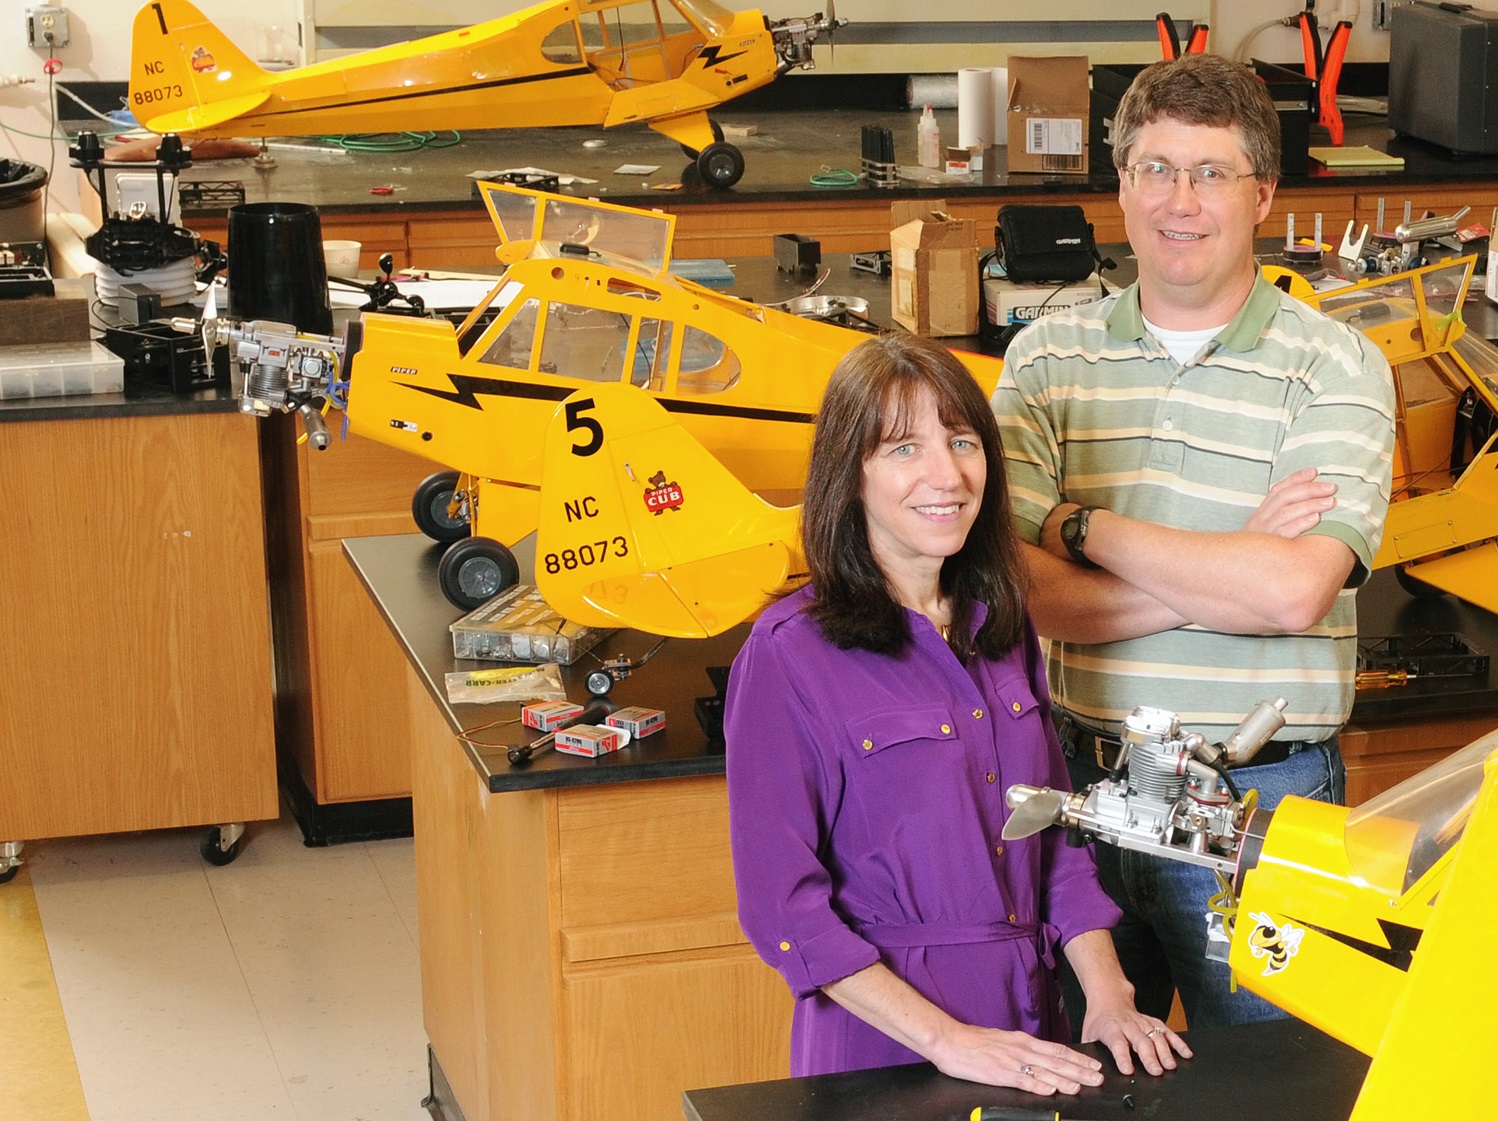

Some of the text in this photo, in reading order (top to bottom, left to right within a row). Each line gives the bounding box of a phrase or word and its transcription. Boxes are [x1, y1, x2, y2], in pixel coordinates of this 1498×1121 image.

[151, 3, 168, 35] 1
[144, 61, 164, 76] NC
[133, 85, 183, 105] 88073
[1015, 305, 1069, 319] GARMI
[565, 398, 604, 457] 5
[647, 491, 681, 507] CUB
[651, 487, 673, 497] PIPER
[564, 496, 599, 523] NC
[544, 536, 629, 575] 88073
